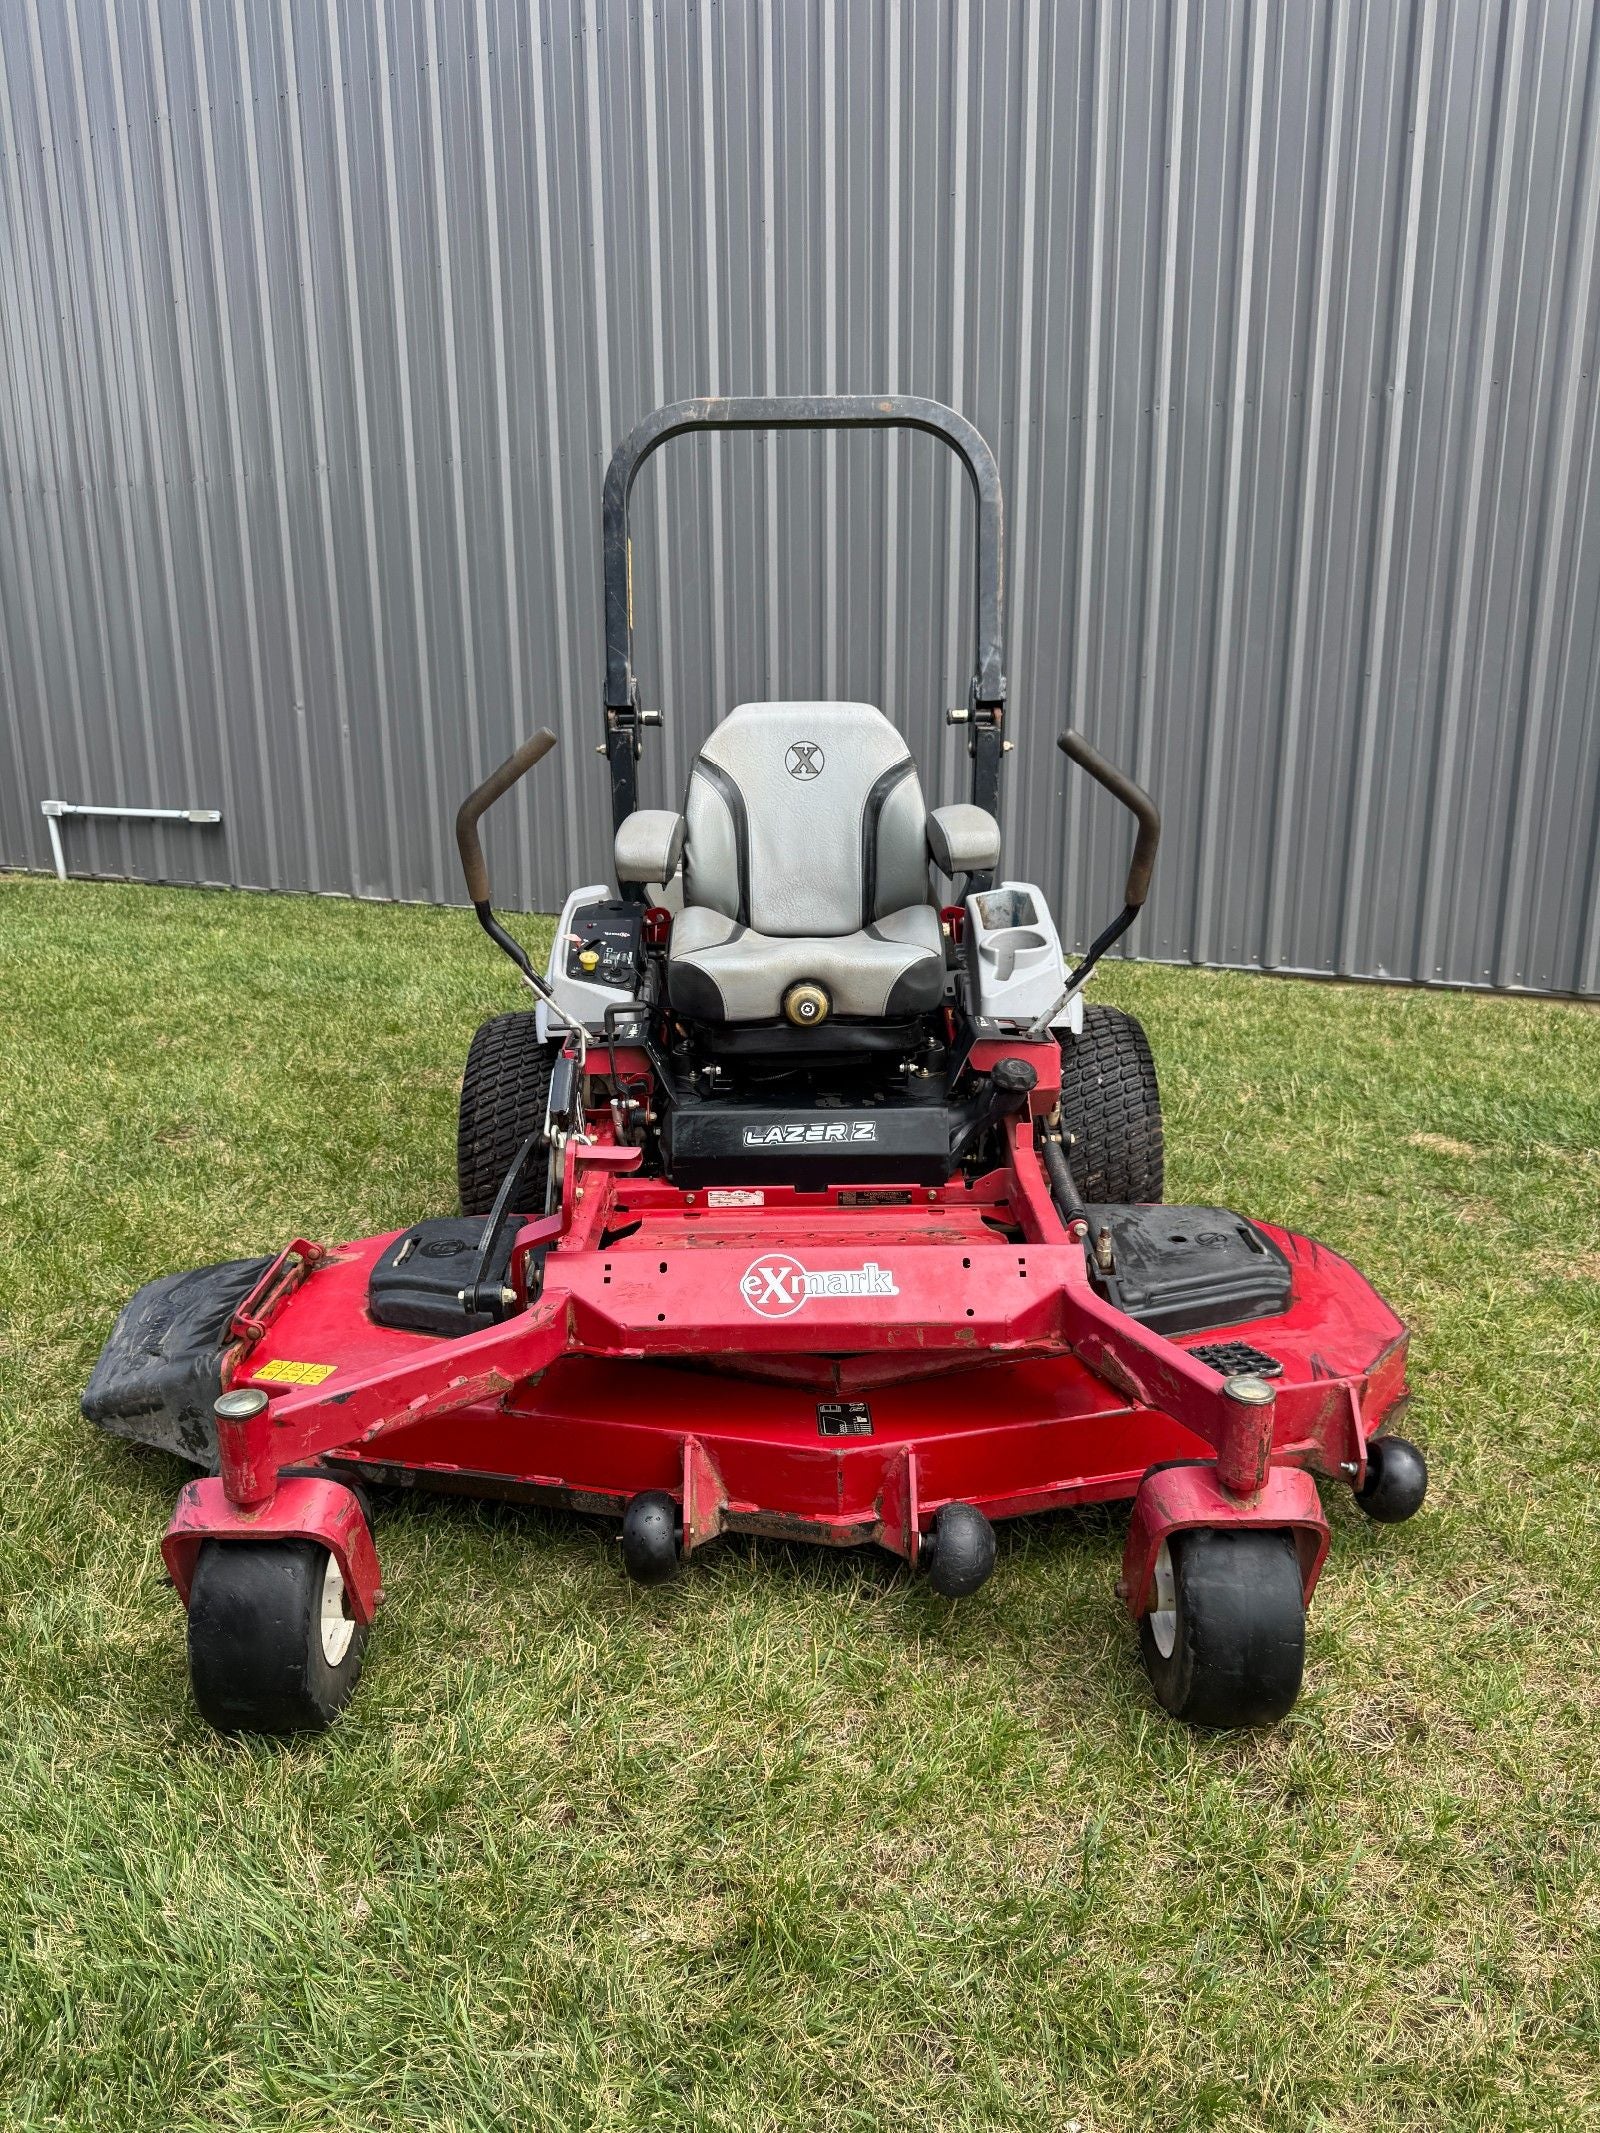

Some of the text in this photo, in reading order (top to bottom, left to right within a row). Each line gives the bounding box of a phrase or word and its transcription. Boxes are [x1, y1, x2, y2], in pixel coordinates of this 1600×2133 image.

[789, 745, 820, 775] X
[744, 1121, 876, 1145] LAZER Z
